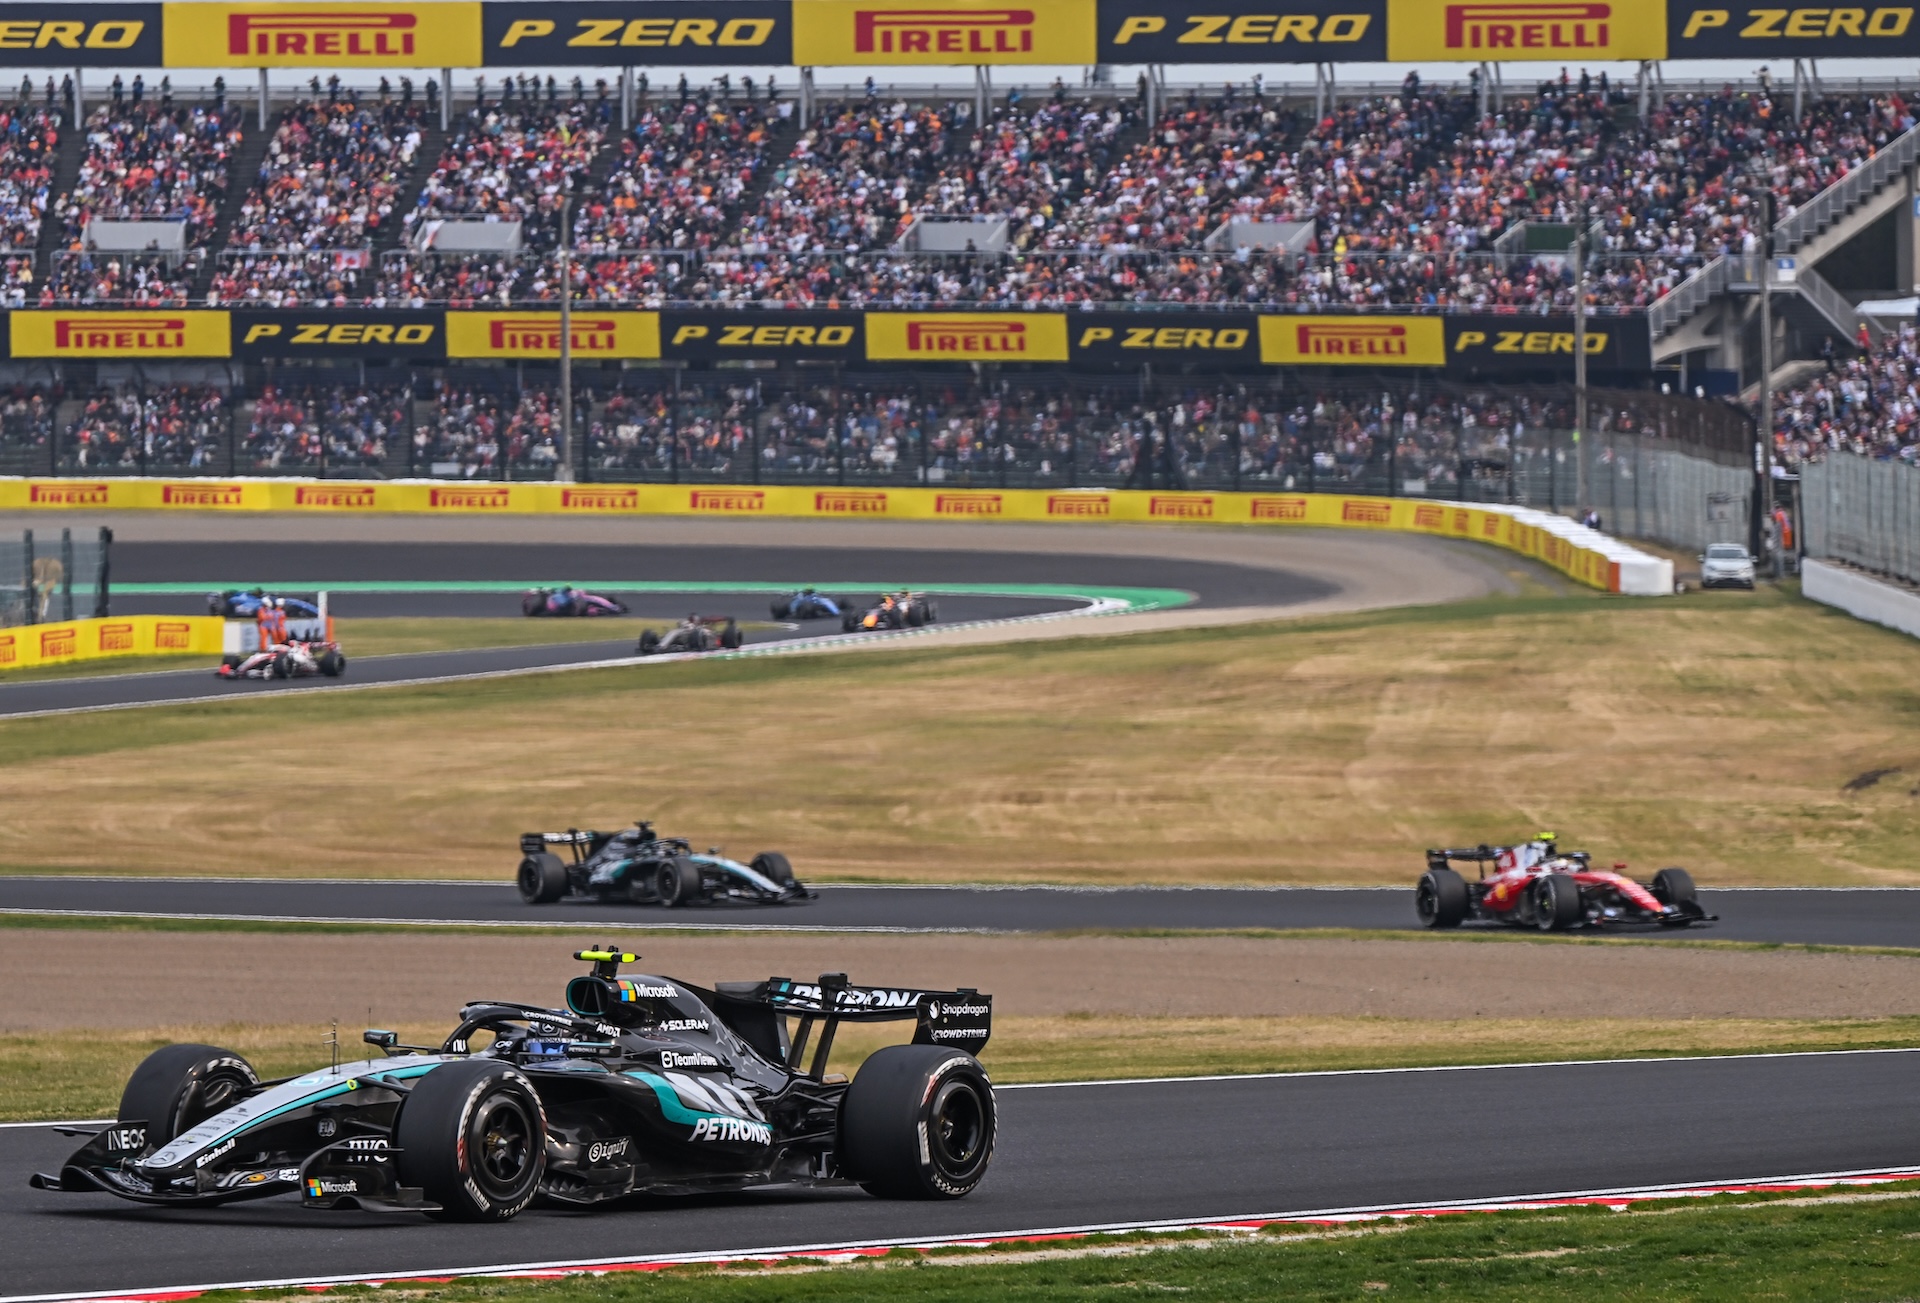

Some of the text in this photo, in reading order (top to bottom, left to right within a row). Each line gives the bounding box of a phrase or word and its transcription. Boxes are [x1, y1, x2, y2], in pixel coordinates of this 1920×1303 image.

[854, 10, 1035, 53] PIRELLI
[1114, 15, 1371, 44] P ZERO
[1445, 4, 1612, 48] PIRELLI
[1683, 8, 1914, 37] P ZERO
[228, 13, 417, 55] PIRELLI
[501, 19, 775, 47] P ZERO
[55, 319, 185, 348] PIRELLI
[244, 324, 434, 343] P ZERO
[490, 320, 616, 349] PIRELLI
[672, 326, 853, 346] P ZERO
[907, 321, 1026, 352] PIRELLI
[1079, 328, 1248, 348] P ZERO
[1297, 324, 1406, 355] PIRELLI
[1455, 331, 1608, 353] P ZERO
[30, 485, 108, 503] PIRELLI
[162, 485, 242, 505] PIRELLI
[295, 487, 375, 506] PIRELLI
[430, 488, 509, 507] PIRELLI
[562, 489, 638, 509] PIRELLI
[690, 490, 764, 510] PIRELLI
[815, 493, 887, 512] PIRELLI
[935, 494, 1002, 514] PIRELLI
[634, 983, 679, 998] Microsoft
[941, 1003, 989, 1017] Snapdragon
[596, 1023, 614, 1036] AMD
[668, 1019, 705, 1031] SOLERA
[933, 1029, 988, 1039] CROWDSTRIKE
[672, 1052, 719, 1067] TeamViewer
[107, 1128, 147, 1151] INEOS
[688, 1117, 772, 1147] PETRONAS
[195, 1137, 237, 1169] Einhell
[320, 1179, 358, 1193] Microsoft
